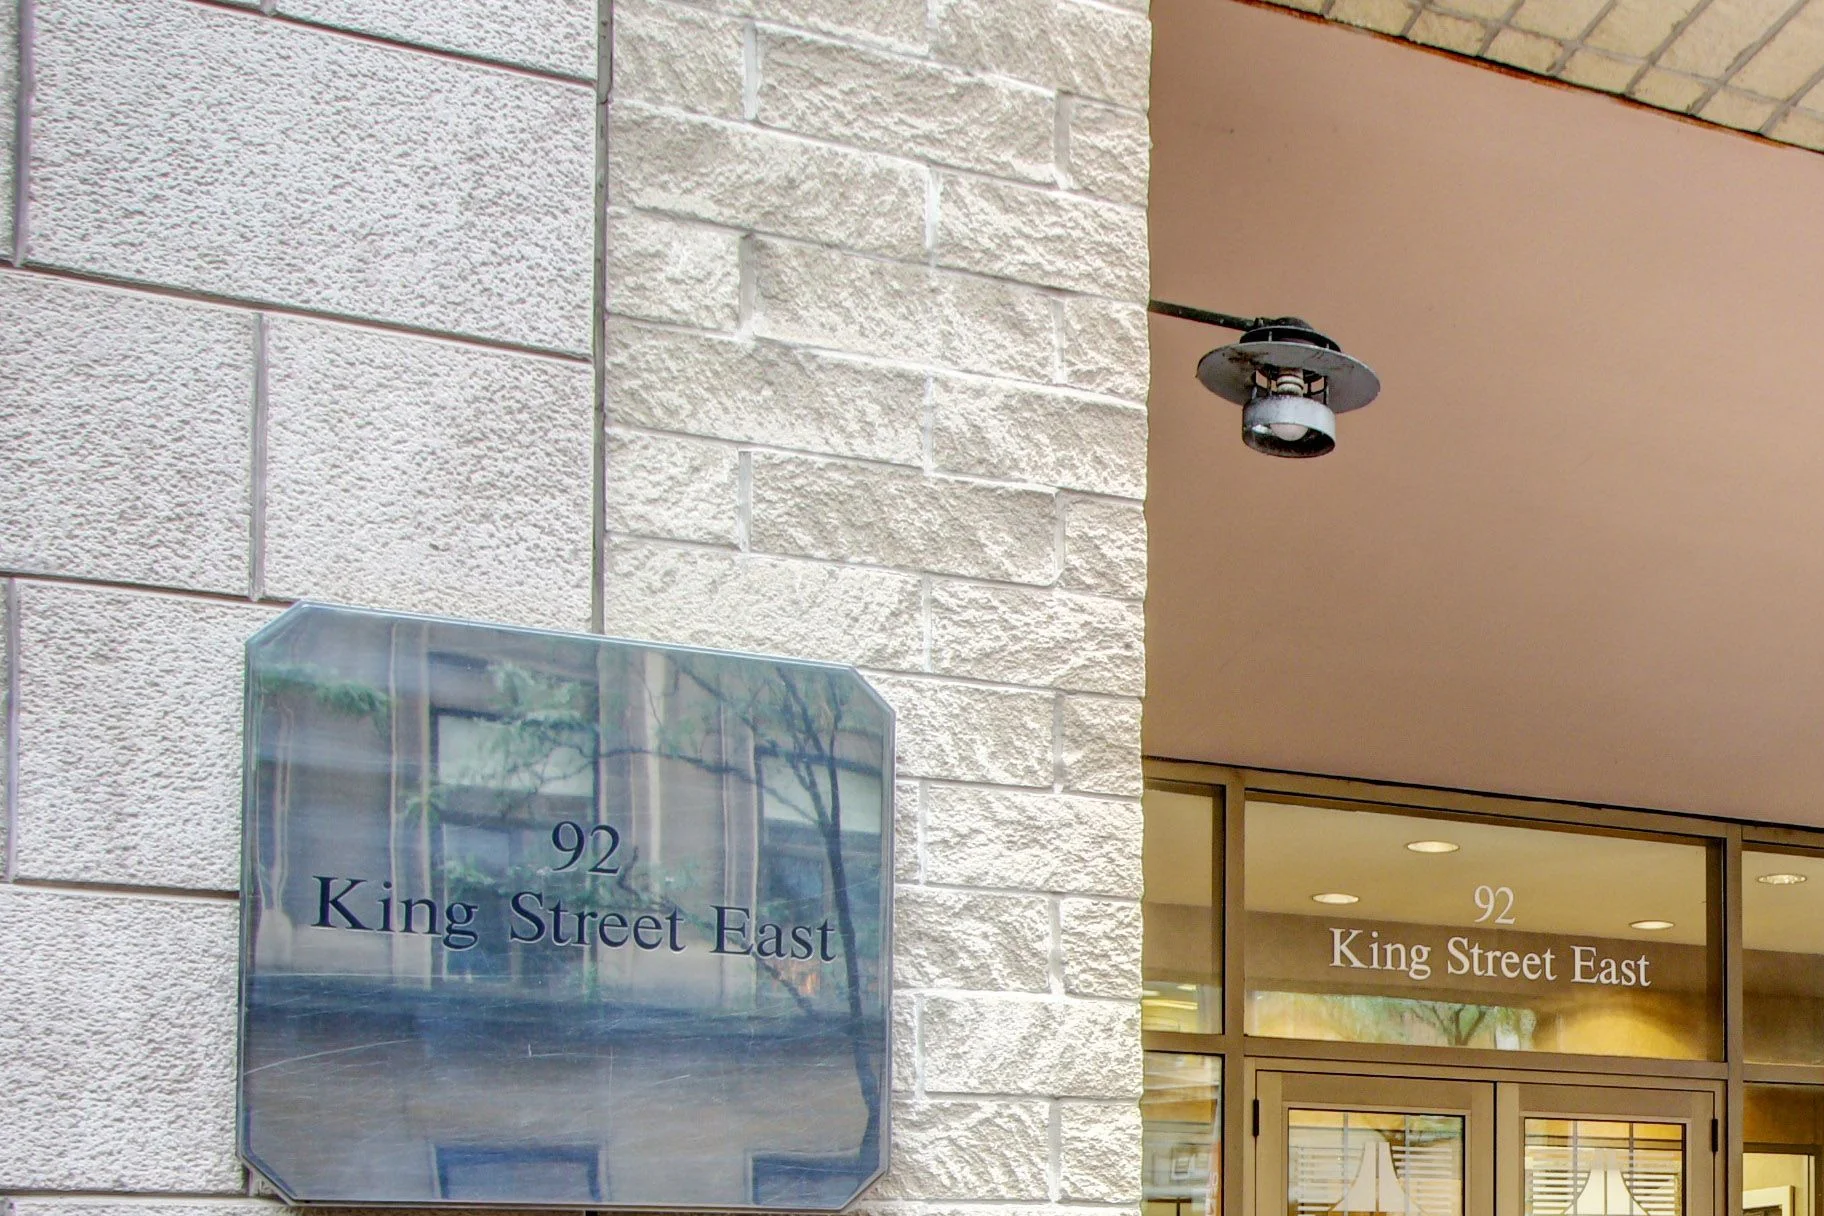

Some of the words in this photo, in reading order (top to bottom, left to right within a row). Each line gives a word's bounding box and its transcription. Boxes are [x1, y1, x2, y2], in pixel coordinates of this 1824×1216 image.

[551, 820, 623, 876] 92
[309, 875, 480, 951] King
[509, 890, 688, 953] Street
[708, 904, 838, 962] East
[1473, 885, 1516, 925] 92
[1329, 927, 1431, 980] King
[1447, 936, 1557, 982] Street
[1570, 945, 1652, 987] East
